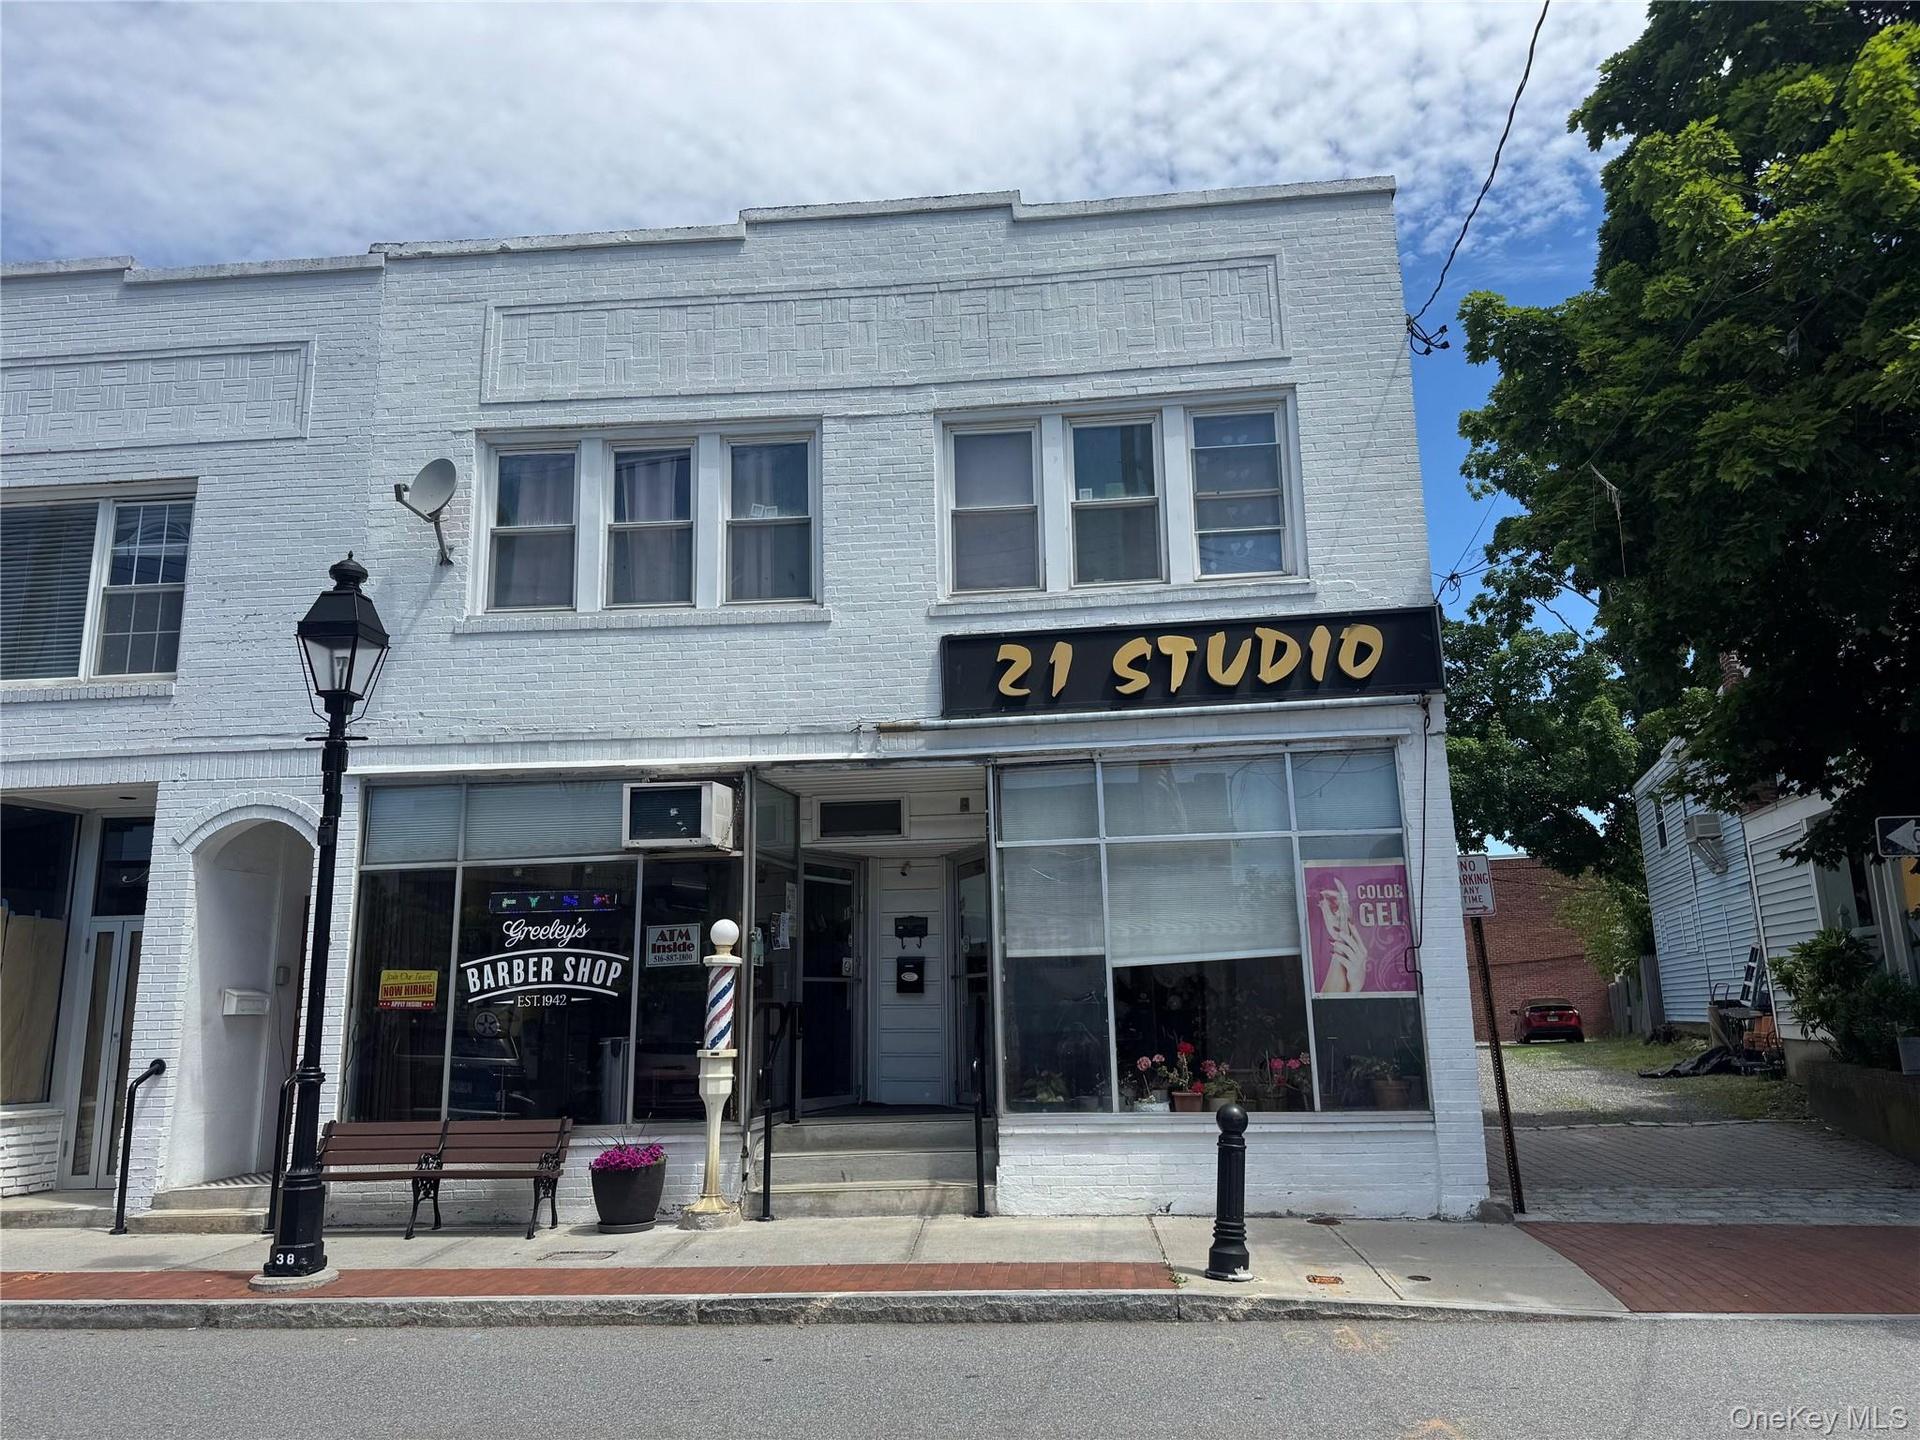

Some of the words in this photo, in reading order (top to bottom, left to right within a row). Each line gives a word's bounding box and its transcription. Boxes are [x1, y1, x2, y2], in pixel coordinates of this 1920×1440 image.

[996, 640, 1074, 698] 21
[1111, 623, 1384, 695] STUDIO
[1459, 860, 1476, 872] NO
[1357, 883, 1405, 900] COLOR
[1463, 886, 1480, 895] ANY
[1463, 895, 1484, 904] TIME
[1359, 901, 1404, 928] GEL
[502, 917, 591, 948] Greeley's
[655, 928, 691, 942] ATM
[651, 941, 695, 954] Inside
[466, 956, 554, 994] BARBER
[563, 956, 623, 987] SHOP
[383, 985, 403, 997] NOW
[404, 983, 433, 996] HIRING
[275, 1252, 295, 1265] 38
